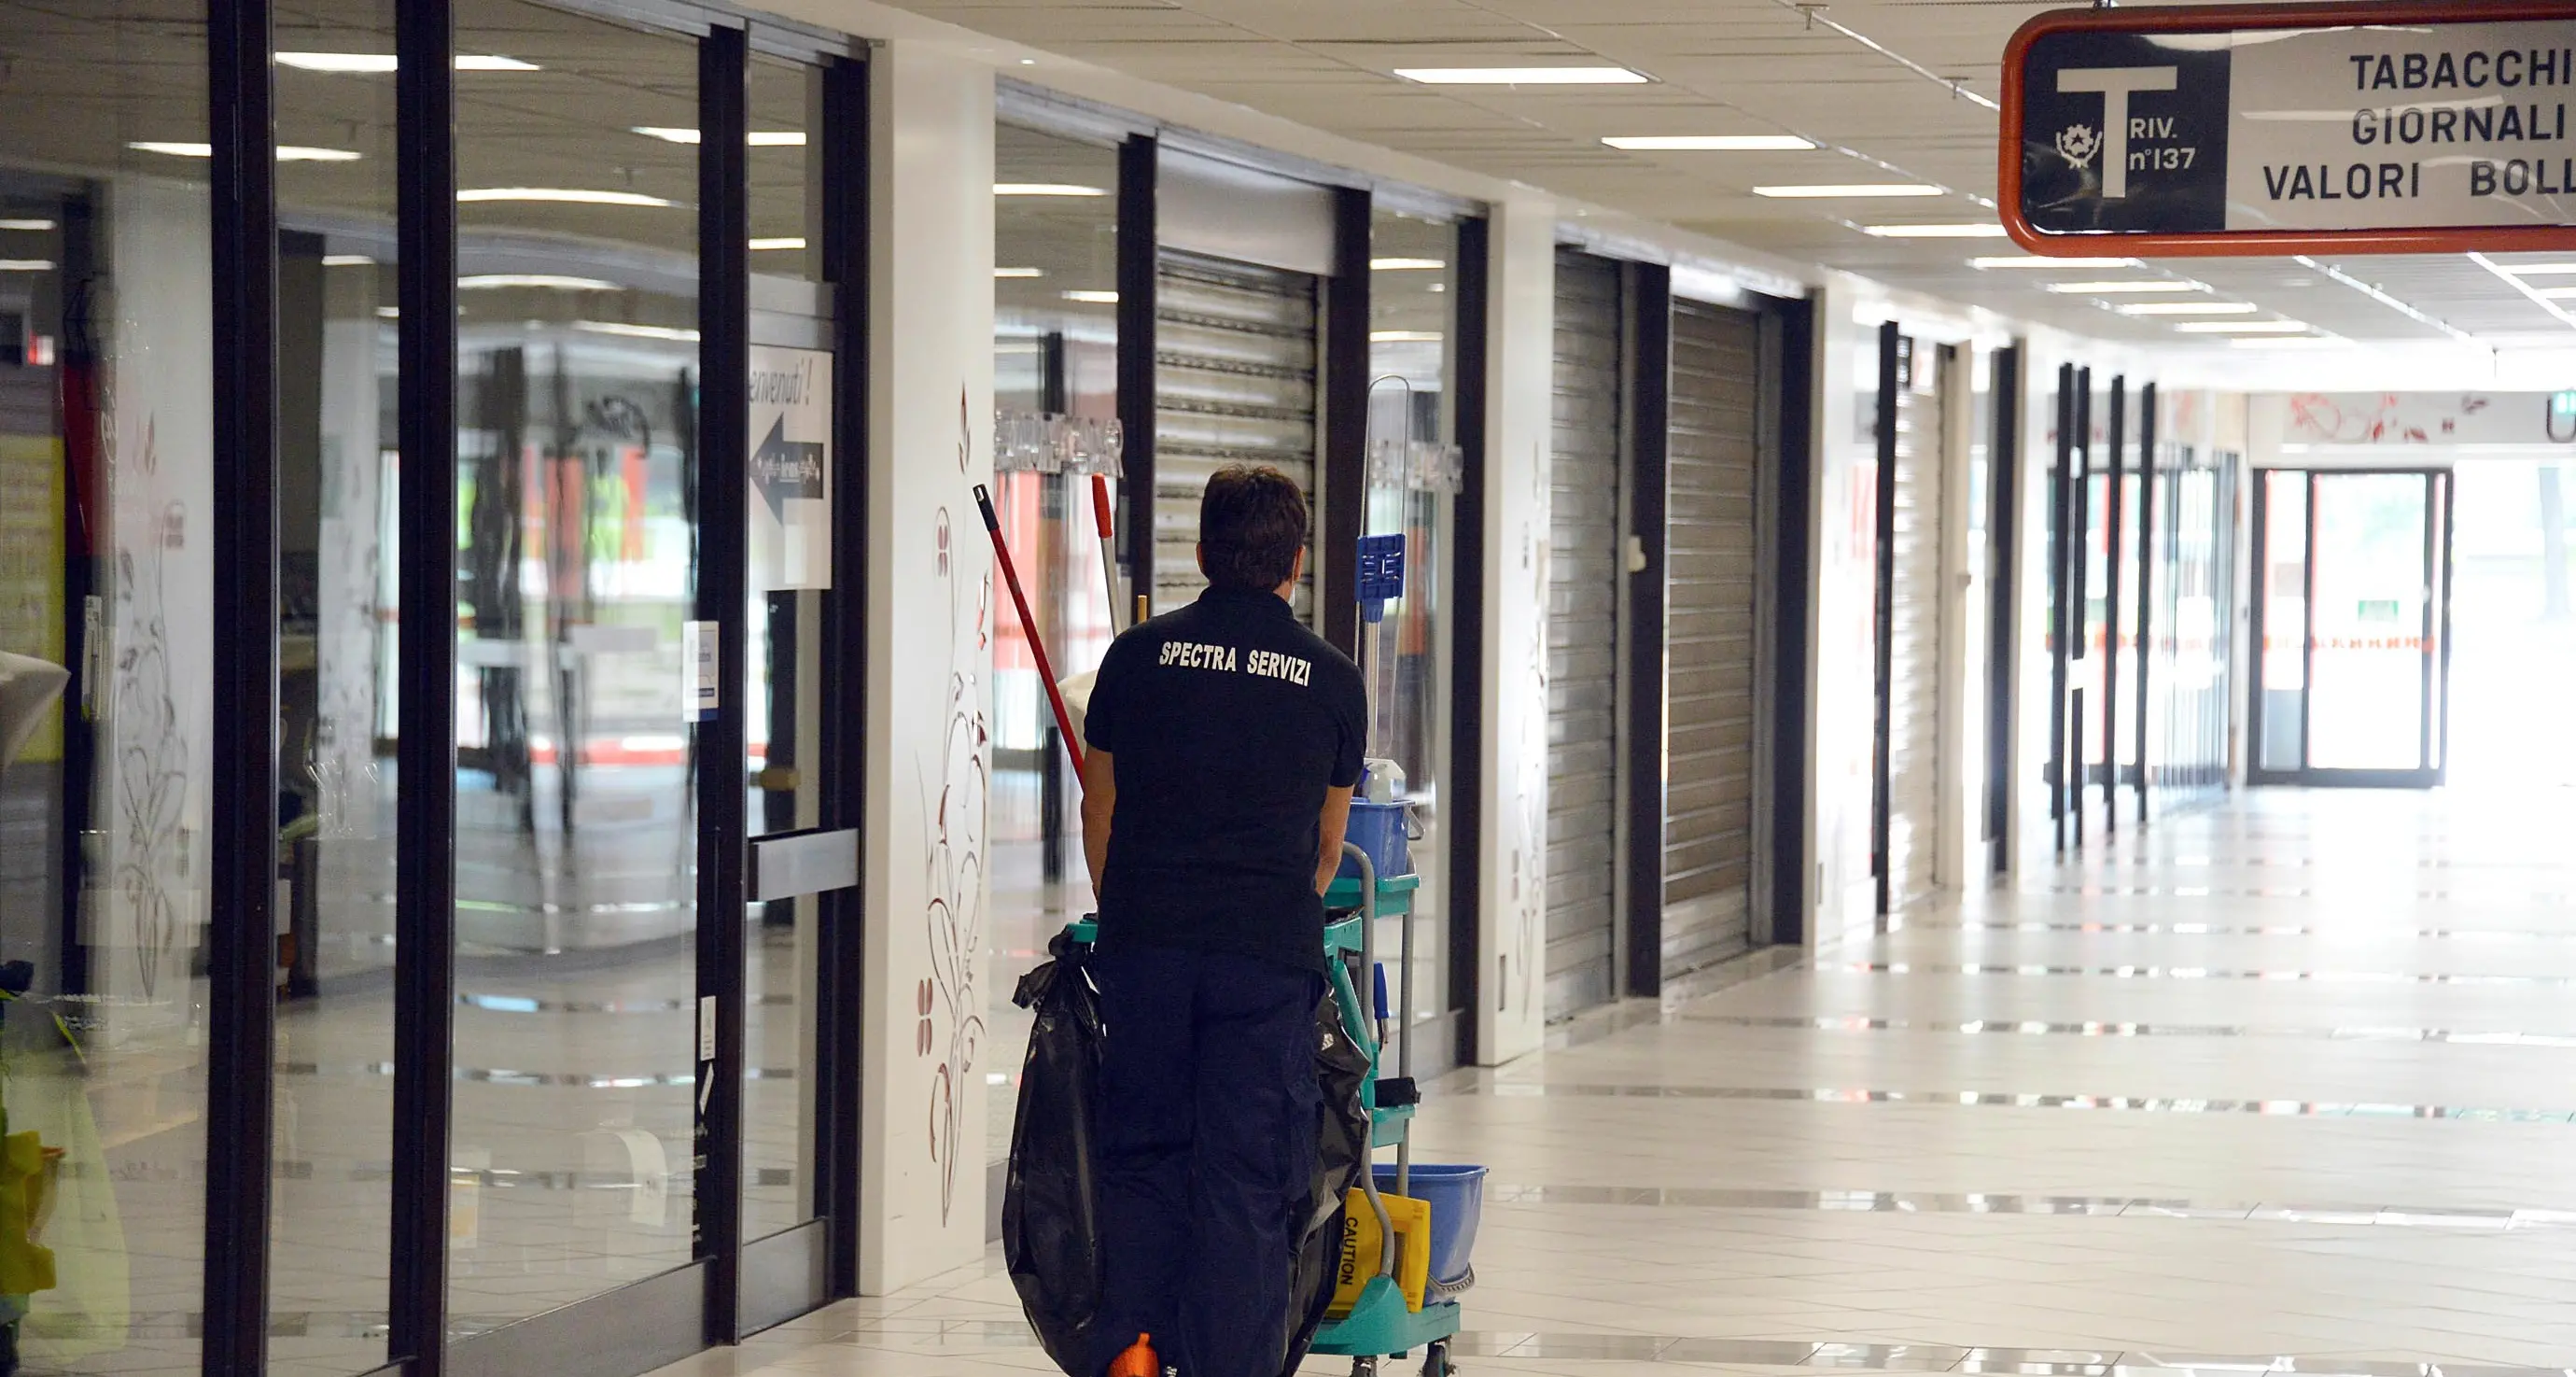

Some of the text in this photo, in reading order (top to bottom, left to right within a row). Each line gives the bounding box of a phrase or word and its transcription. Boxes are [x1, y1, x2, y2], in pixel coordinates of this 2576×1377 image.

[2349, 49, 2571, 91] TABACCHI
[2130, 117, 2177, 139] RIV.
[2352, 104, 2565, 145] GIORNALI
[2262, 161, 2420, 201] VALORI
[1159, 641, 1311, 687] SPECTRA SERVIZI
[1340, 1216, 1358, 1286] CAUTION
